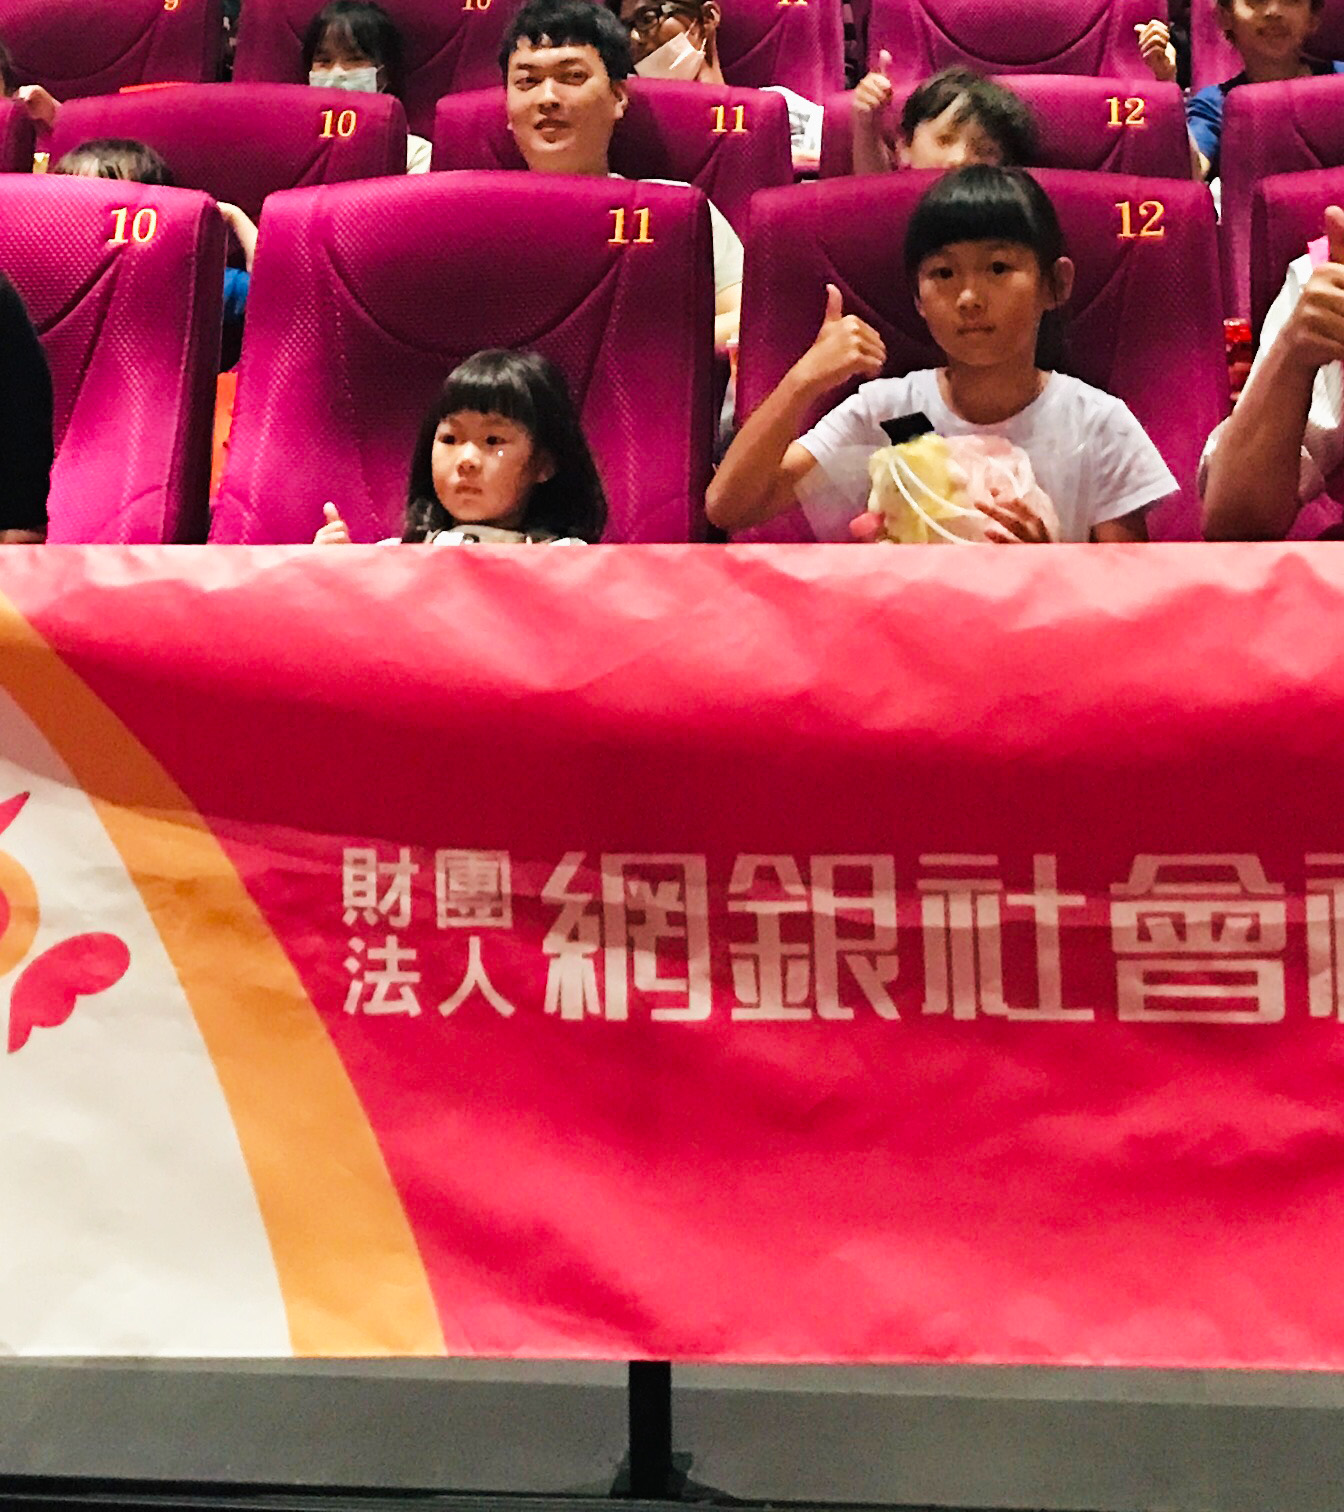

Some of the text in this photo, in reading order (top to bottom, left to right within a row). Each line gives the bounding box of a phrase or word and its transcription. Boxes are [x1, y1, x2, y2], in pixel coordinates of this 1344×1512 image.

[319, 109, 357, 138] 10
[710, 105, 746, 133] 11
[1106, 96, 1146, 126] 12
[108, 206, 158, 243] 10
[607, 208, 656, 245] 11
[1115, 201, 1166, 239] 12
[340, 848, 514, 930] 財團
[342, 936, 516, 1020] 法人
